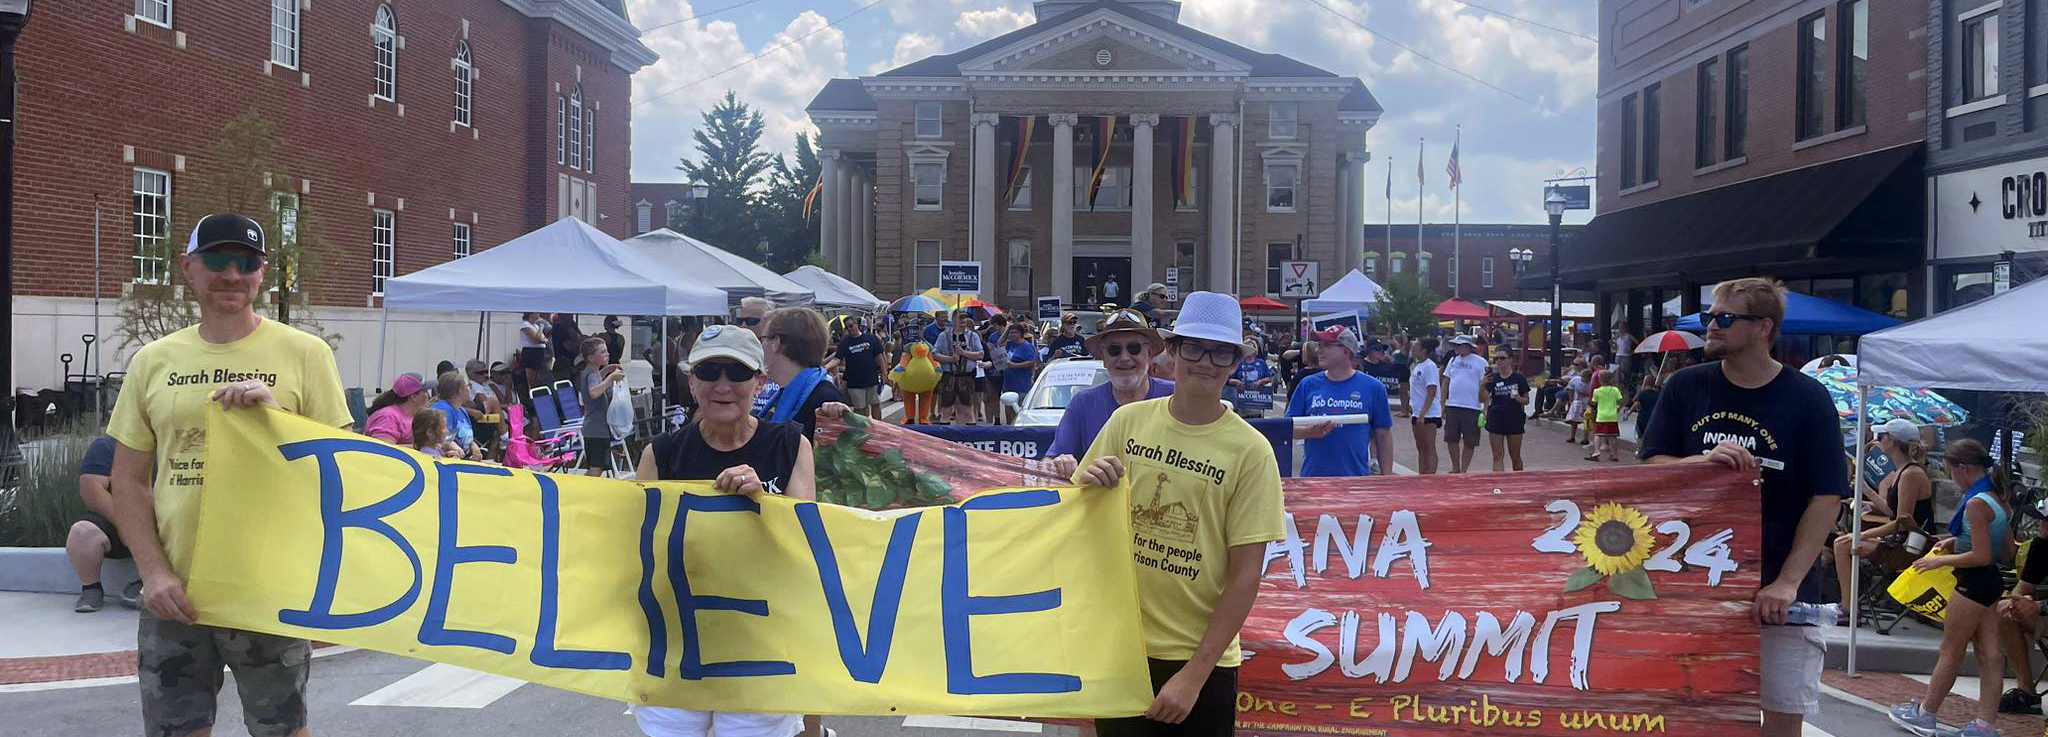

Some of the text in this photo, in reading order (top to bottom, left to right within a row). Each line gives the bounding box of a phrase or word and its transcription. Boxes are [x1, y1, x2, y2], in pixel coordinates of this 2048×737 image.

[167, 368, 277, 387] Sarah Blessing
[1311, 398, 1363, 410] Bob Compton
[1691, 411, 1778, 451] OUT OF MANY, ONE
[1703, 431, 1756, 451] INDIANA
[1000, 441, 1038, 458] BOB
[1125, 438, 1226, 485] Sarah Blessing
[1133, 533, 1203, 563] for the people
[277, 438, 1082, 695] BELIEVE
[1160, 558, 1200, 581] County
[1280, 601, 1622, 691] SUMMIT
[1235, 691, 1298, 716] One
[1350, 697, 1373, 718] E
[1390, 694, 1543, 728] Pluribus
[1559, 709, 1666, 733] unum
